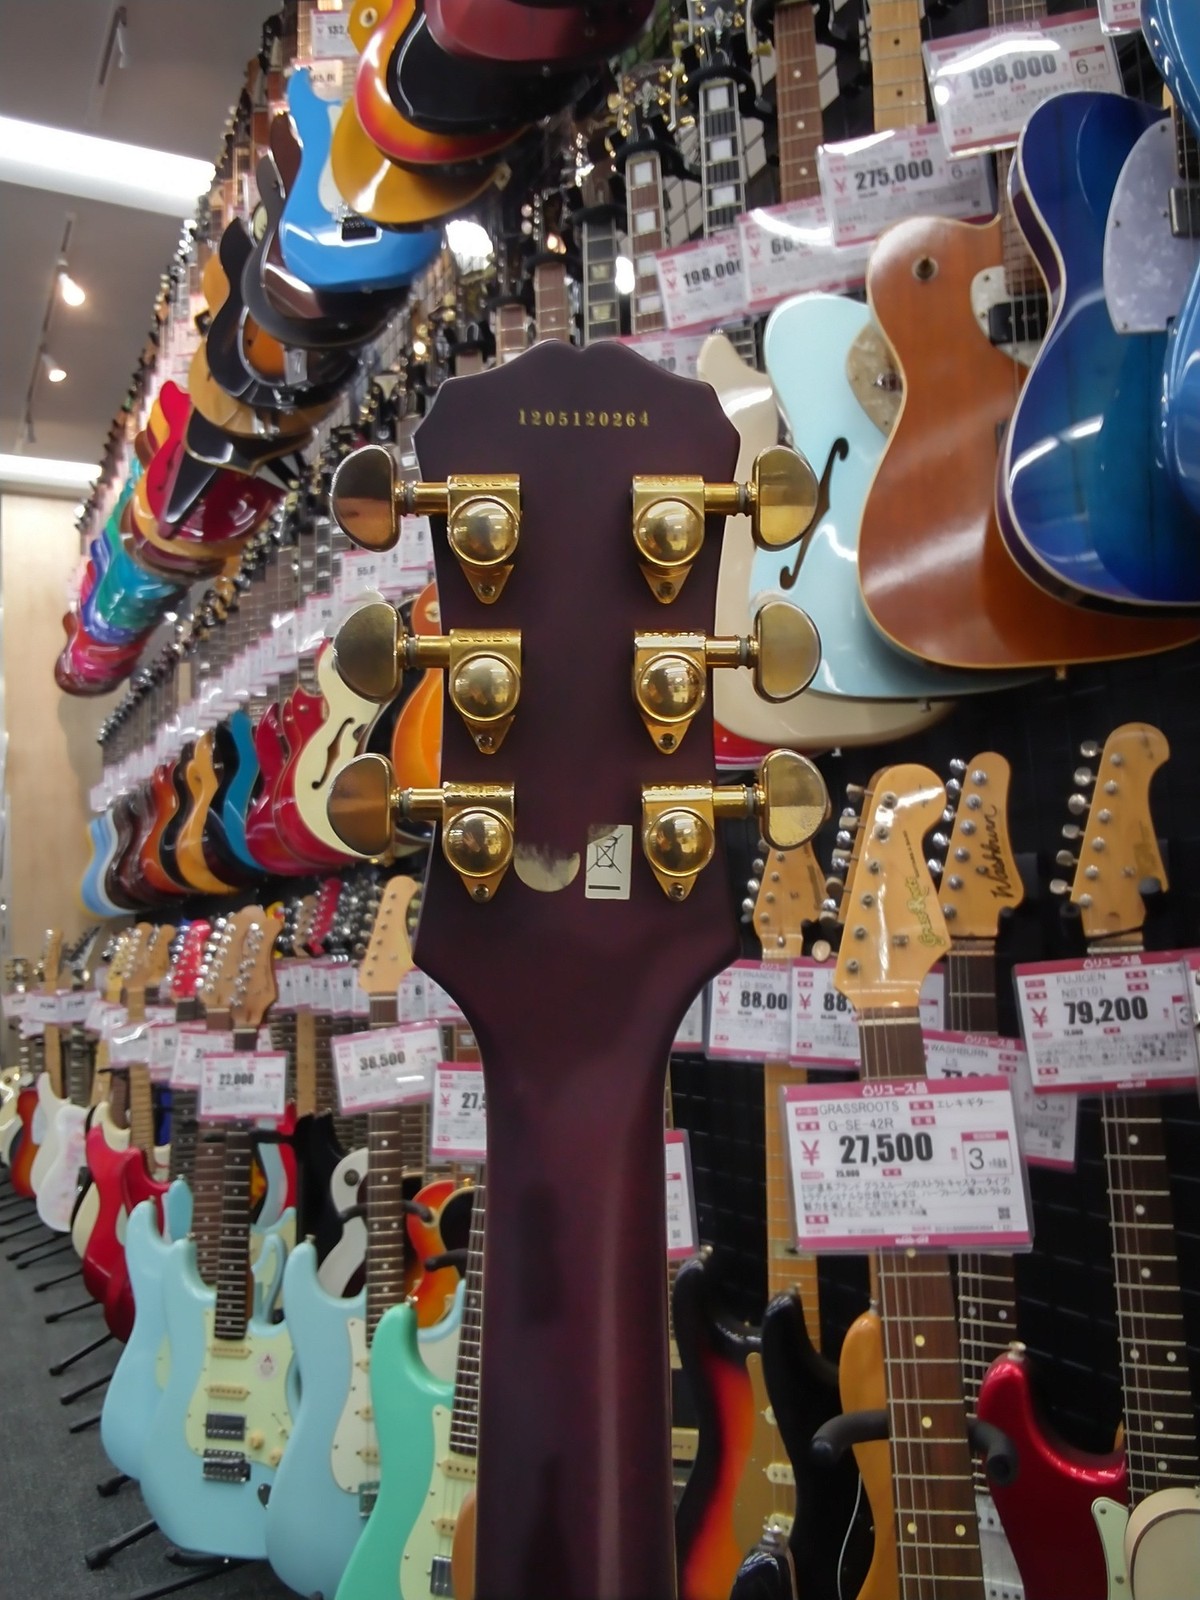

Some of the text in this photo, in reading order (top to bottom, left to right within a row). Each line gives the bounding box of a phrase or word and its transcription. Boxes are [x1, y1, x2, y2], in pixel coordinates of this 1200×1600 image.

[968, 54, 1057, 91] 198,000
[1075, 58, 1090, 75] 6
[854, 158, 934, 191] 275,000
[518, 408, 650, 427] 1205120264
[983, 804, 1014, 899] Washburn
[1056, 973, 1106, 985] FUJIGEN
[718, 990, 788, 1011] ¥ 88,00
[799, 993, 854, 1014] ¥ 88,
[1031, 996, 1148, 1028] ¥ 79,200
[931, 1043, 989, 1058] WASHBURN
[360, 1051, 406, 1071] 38,500
[873, 1082, 928, 1096] リユース品
[440, 1093, 451, 1108] ¥
[820, 1100, 900, 1116] GRASSROOTS
[937, 1097, 994, 1109] エレキギター
[828, 1117, 895, 1132] G-SE-42R
[800, 1139, 820, 1166] ¥
[839, 1131, 934, 1166] 27,500
[968, 1146, 985, 1170] 3
